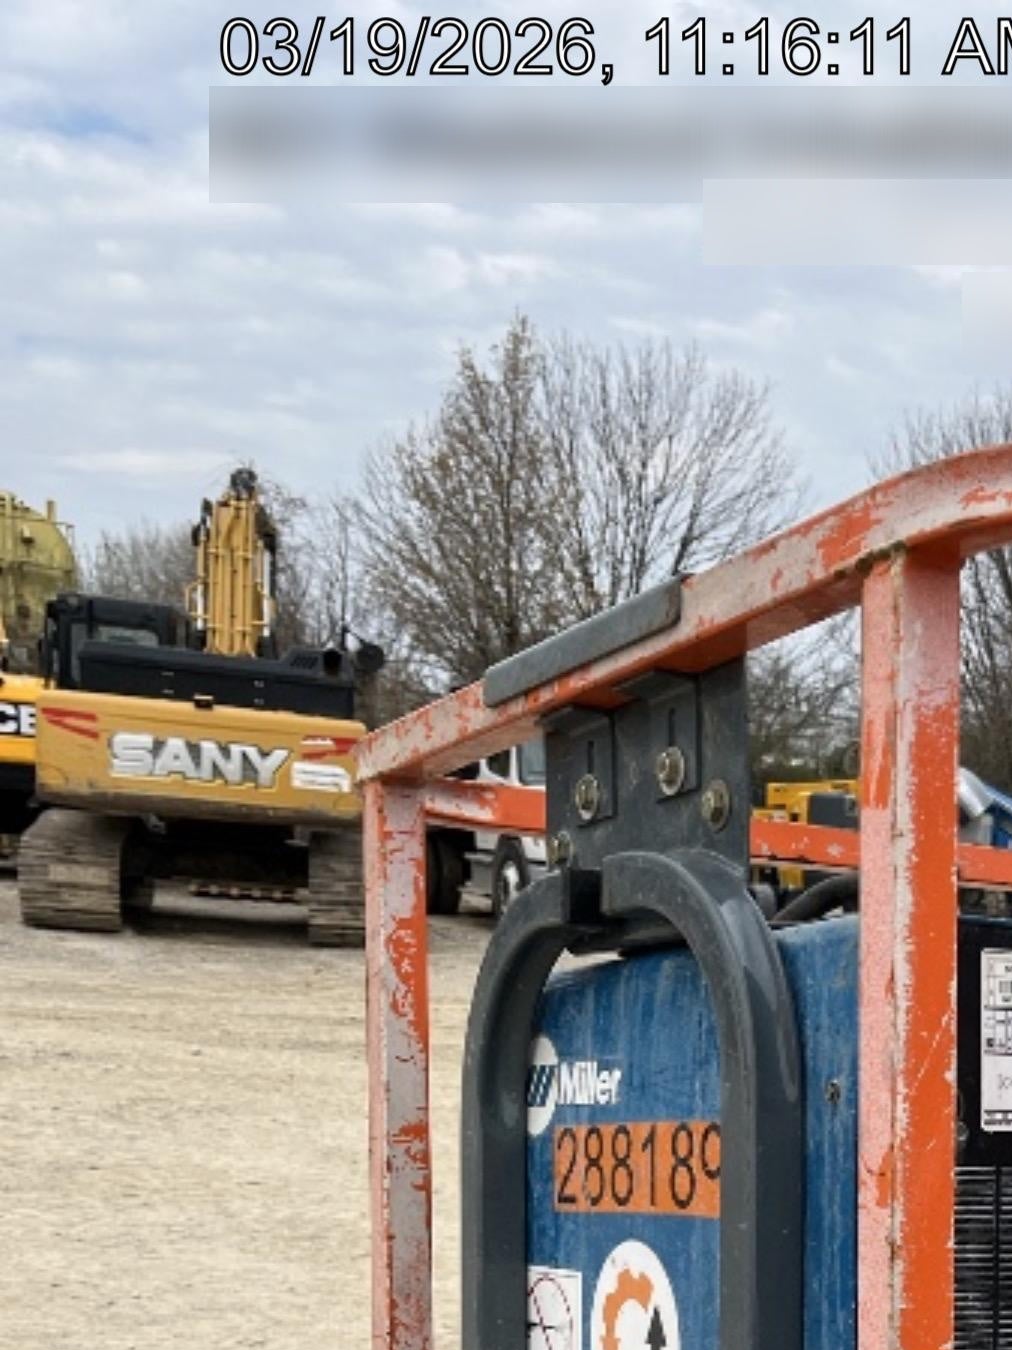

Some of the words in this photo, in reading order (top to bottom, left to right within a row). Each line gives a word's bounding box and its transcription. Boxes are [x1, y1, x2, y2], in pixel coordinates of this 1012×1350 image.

[109, 732, 291, 790] SANY
[557, 1060, 622, 1105] Miller
[557, 1121, 721, 1209] 288189
